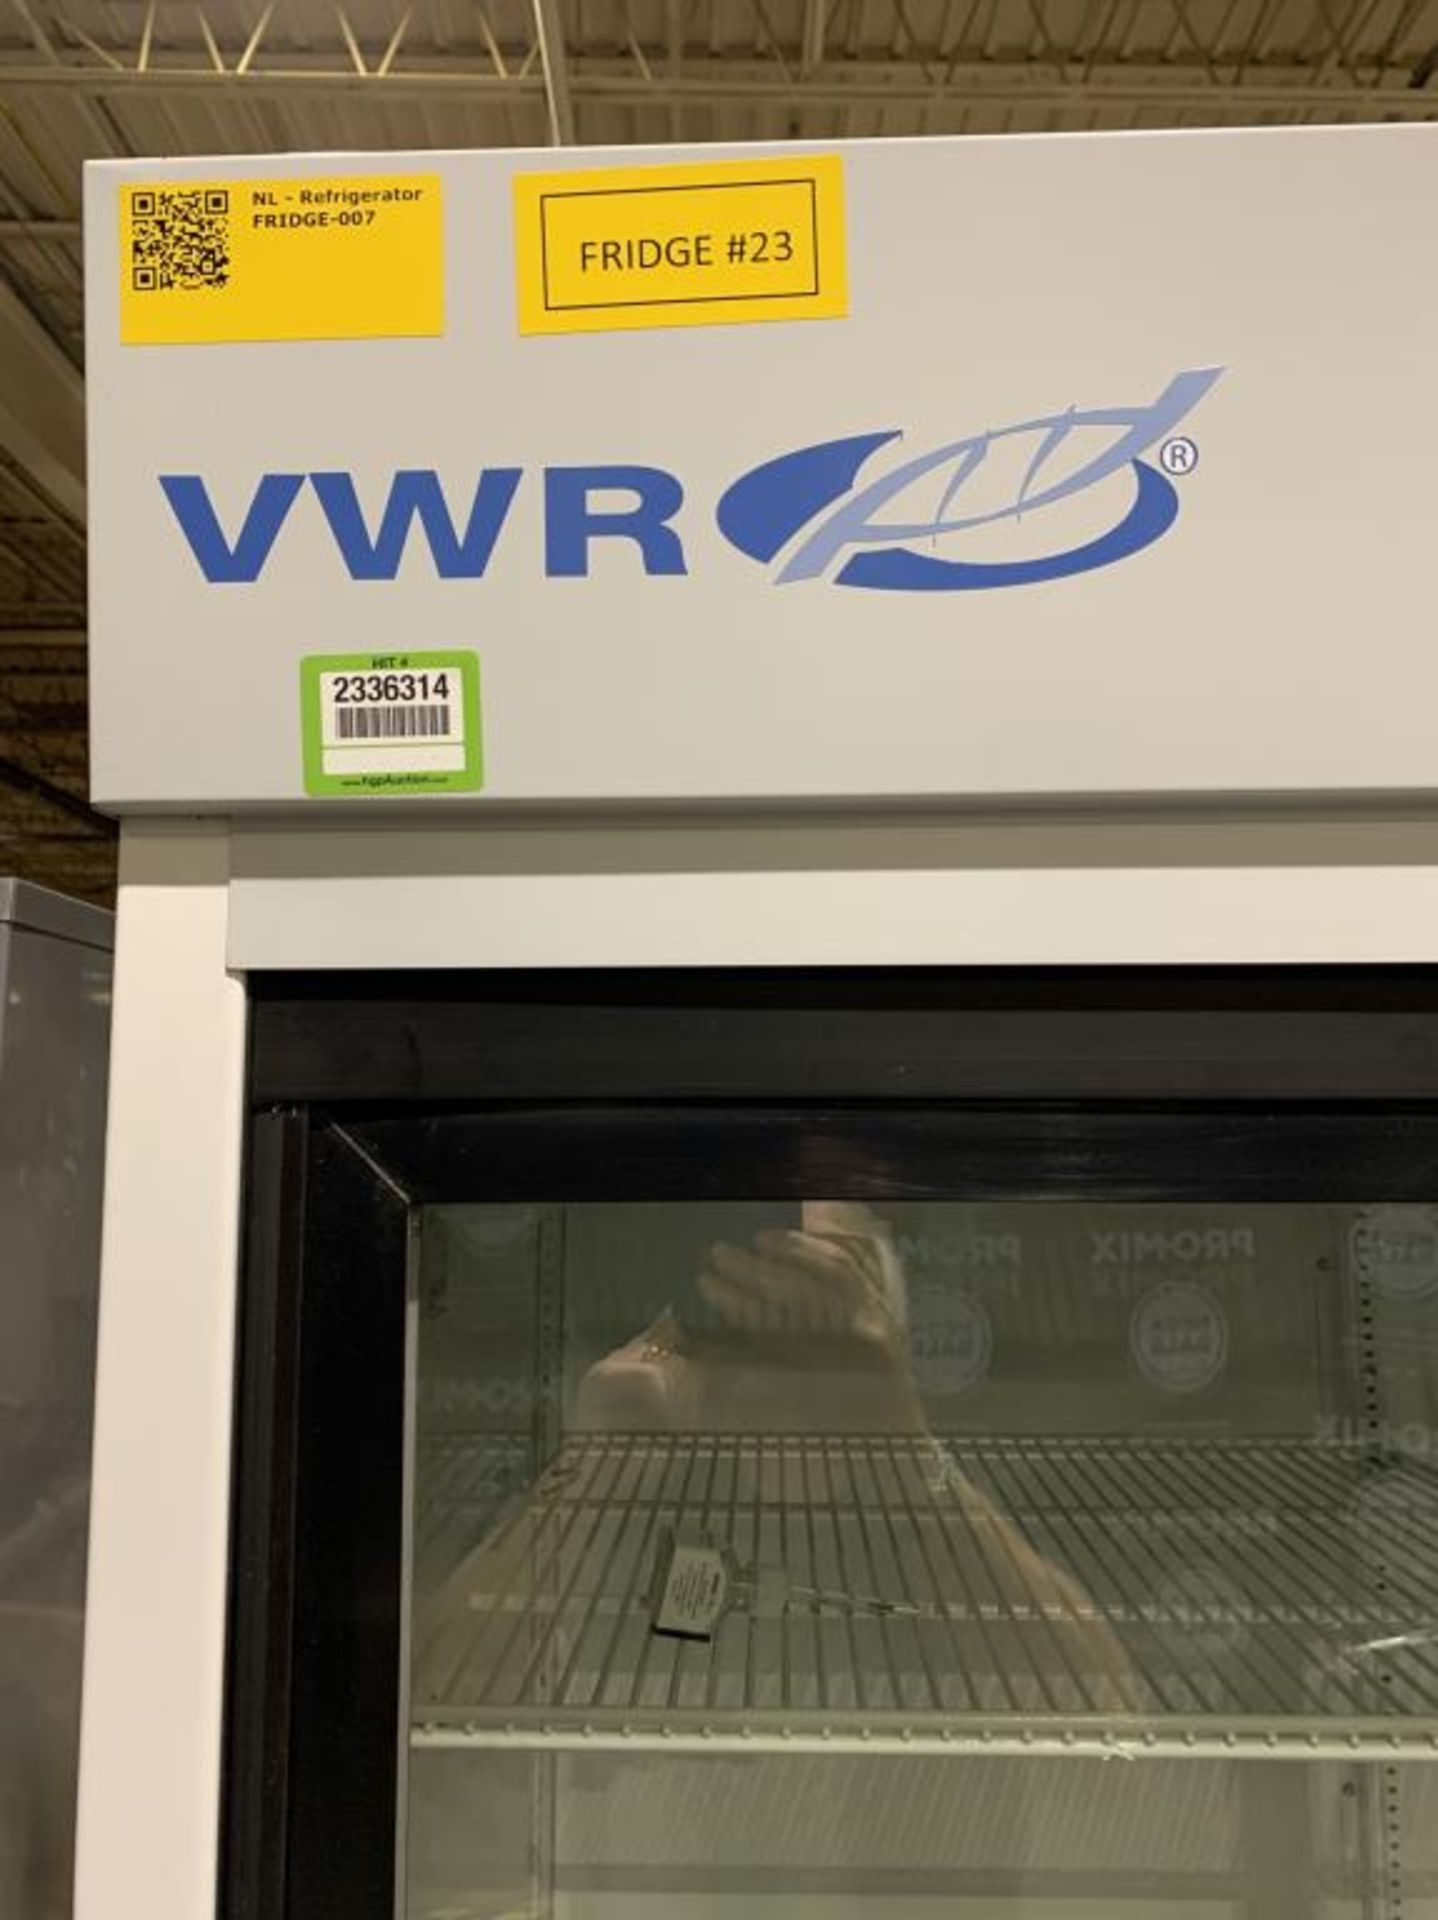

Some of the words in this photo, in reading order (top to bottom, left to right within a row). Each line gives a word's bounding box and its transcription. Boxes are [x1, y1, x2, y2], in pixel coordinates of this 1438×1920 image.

[252, 192, 278, 206] NL
[300, 188, 422, 206] Refrigerator
[252, 210, 376, 229] FRIDGE-007
[580, 235, 714, 273] FRIDGE
[727, 230, 794, 264] #23
[158, 465, 688, 583] VWR
[332, 673, 450, 703] 2336314
